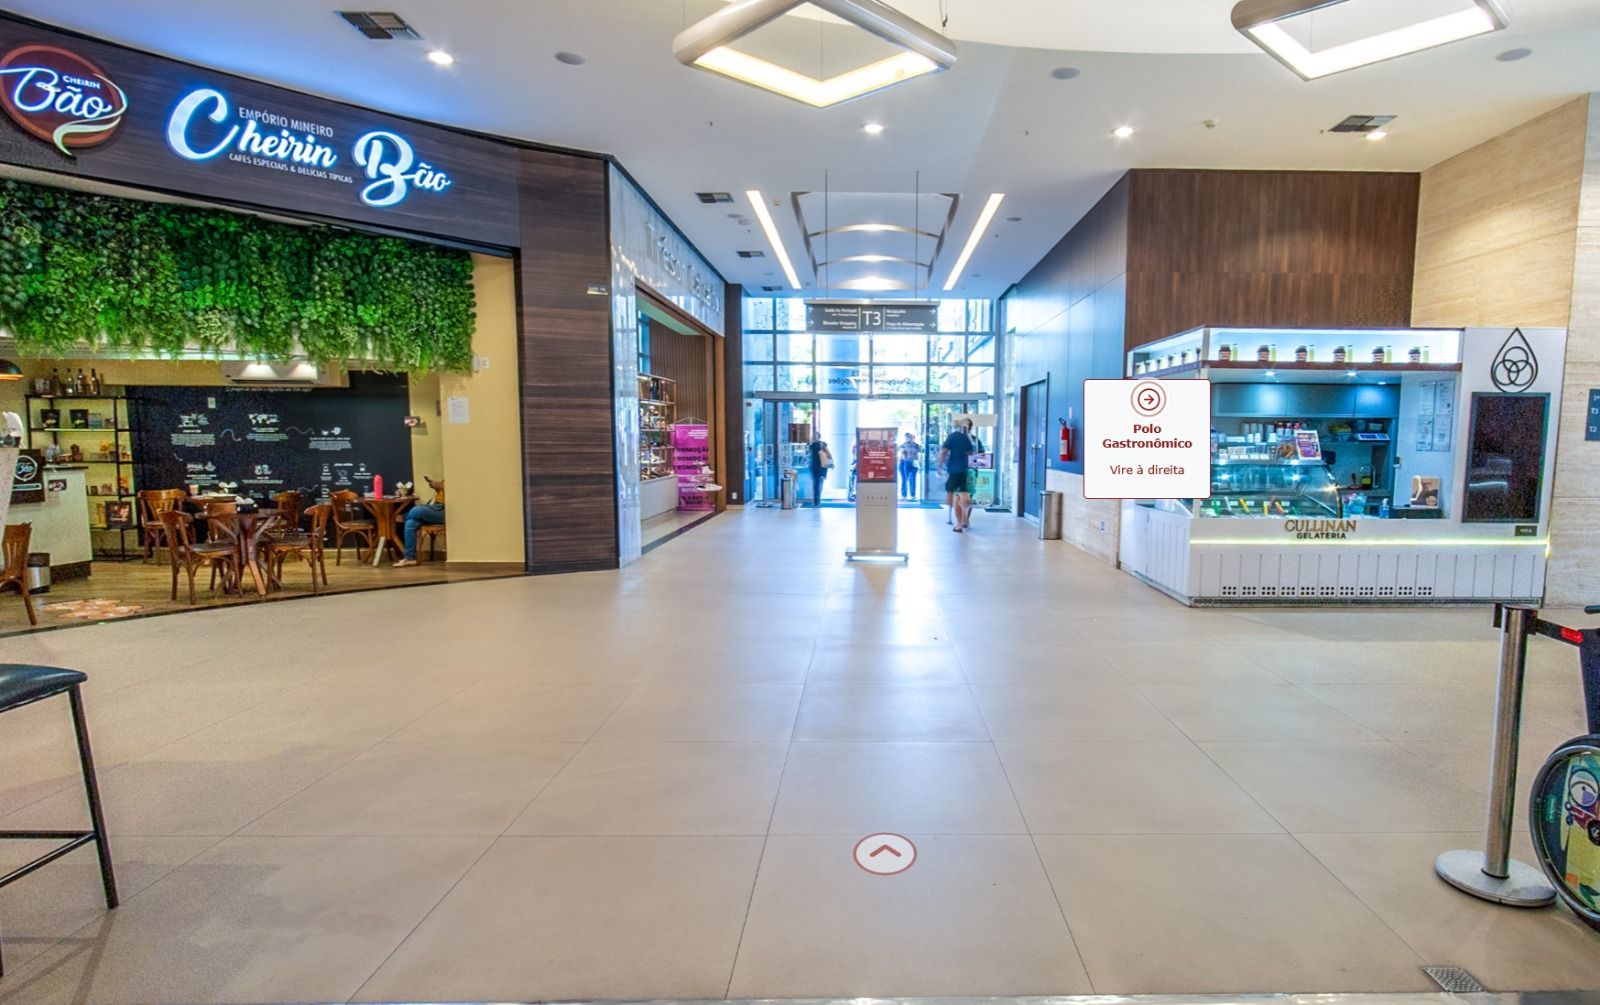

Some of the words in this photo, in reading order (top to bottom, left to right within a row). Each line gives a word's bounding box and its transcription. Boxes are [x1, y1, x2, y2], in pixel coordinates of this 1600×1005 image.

[63, 75, 101, 89] CHEIRIN
[0, 67, 113, 118] Bão
[168, 88, 337, 168] Cheirin
[239, 107, 288, 127] EMPÓRIO
[290, 119, 334, 138] MINEIRO
[252, 157, 289, 172] ESPECIAIS
[354, 131, 450, 207] Bão
[862, 310, 881, 326] T3
[1285, 519, 1357, 532] CULLINAN
[1296, 532, 1347, 540] GELATERIA
